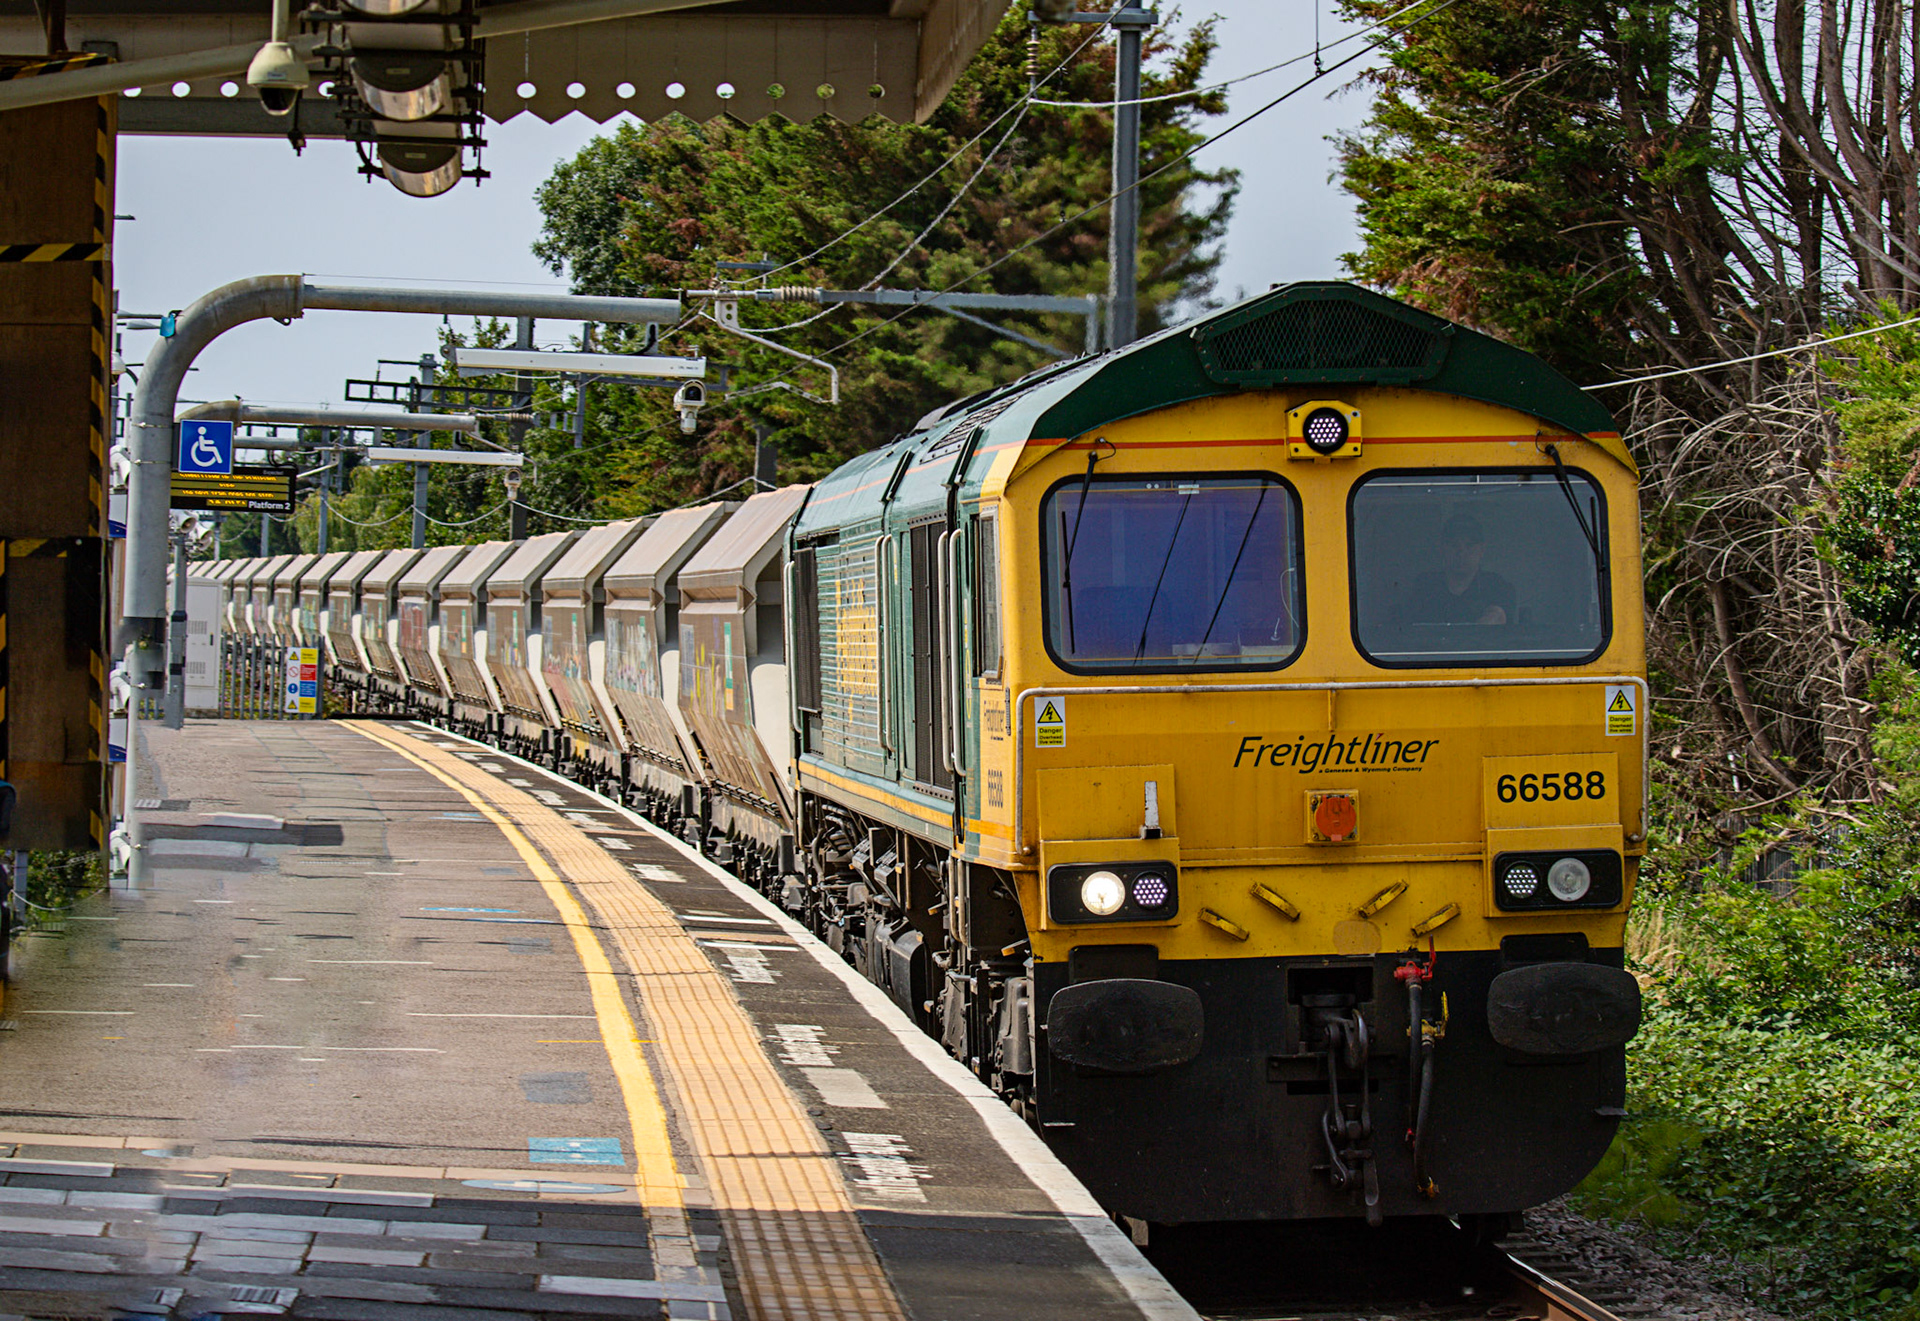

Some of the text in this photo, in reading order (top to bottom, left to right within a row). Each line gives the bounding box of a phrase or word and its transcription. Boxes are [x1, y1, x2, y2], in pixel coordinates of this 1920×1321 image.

[248, 500, 284, 510] Platform
[285, 502, 291, 510] 2
[1233, 732, 1440, 775] Freightliner
[1497, 770, 1606, 803] 66588
